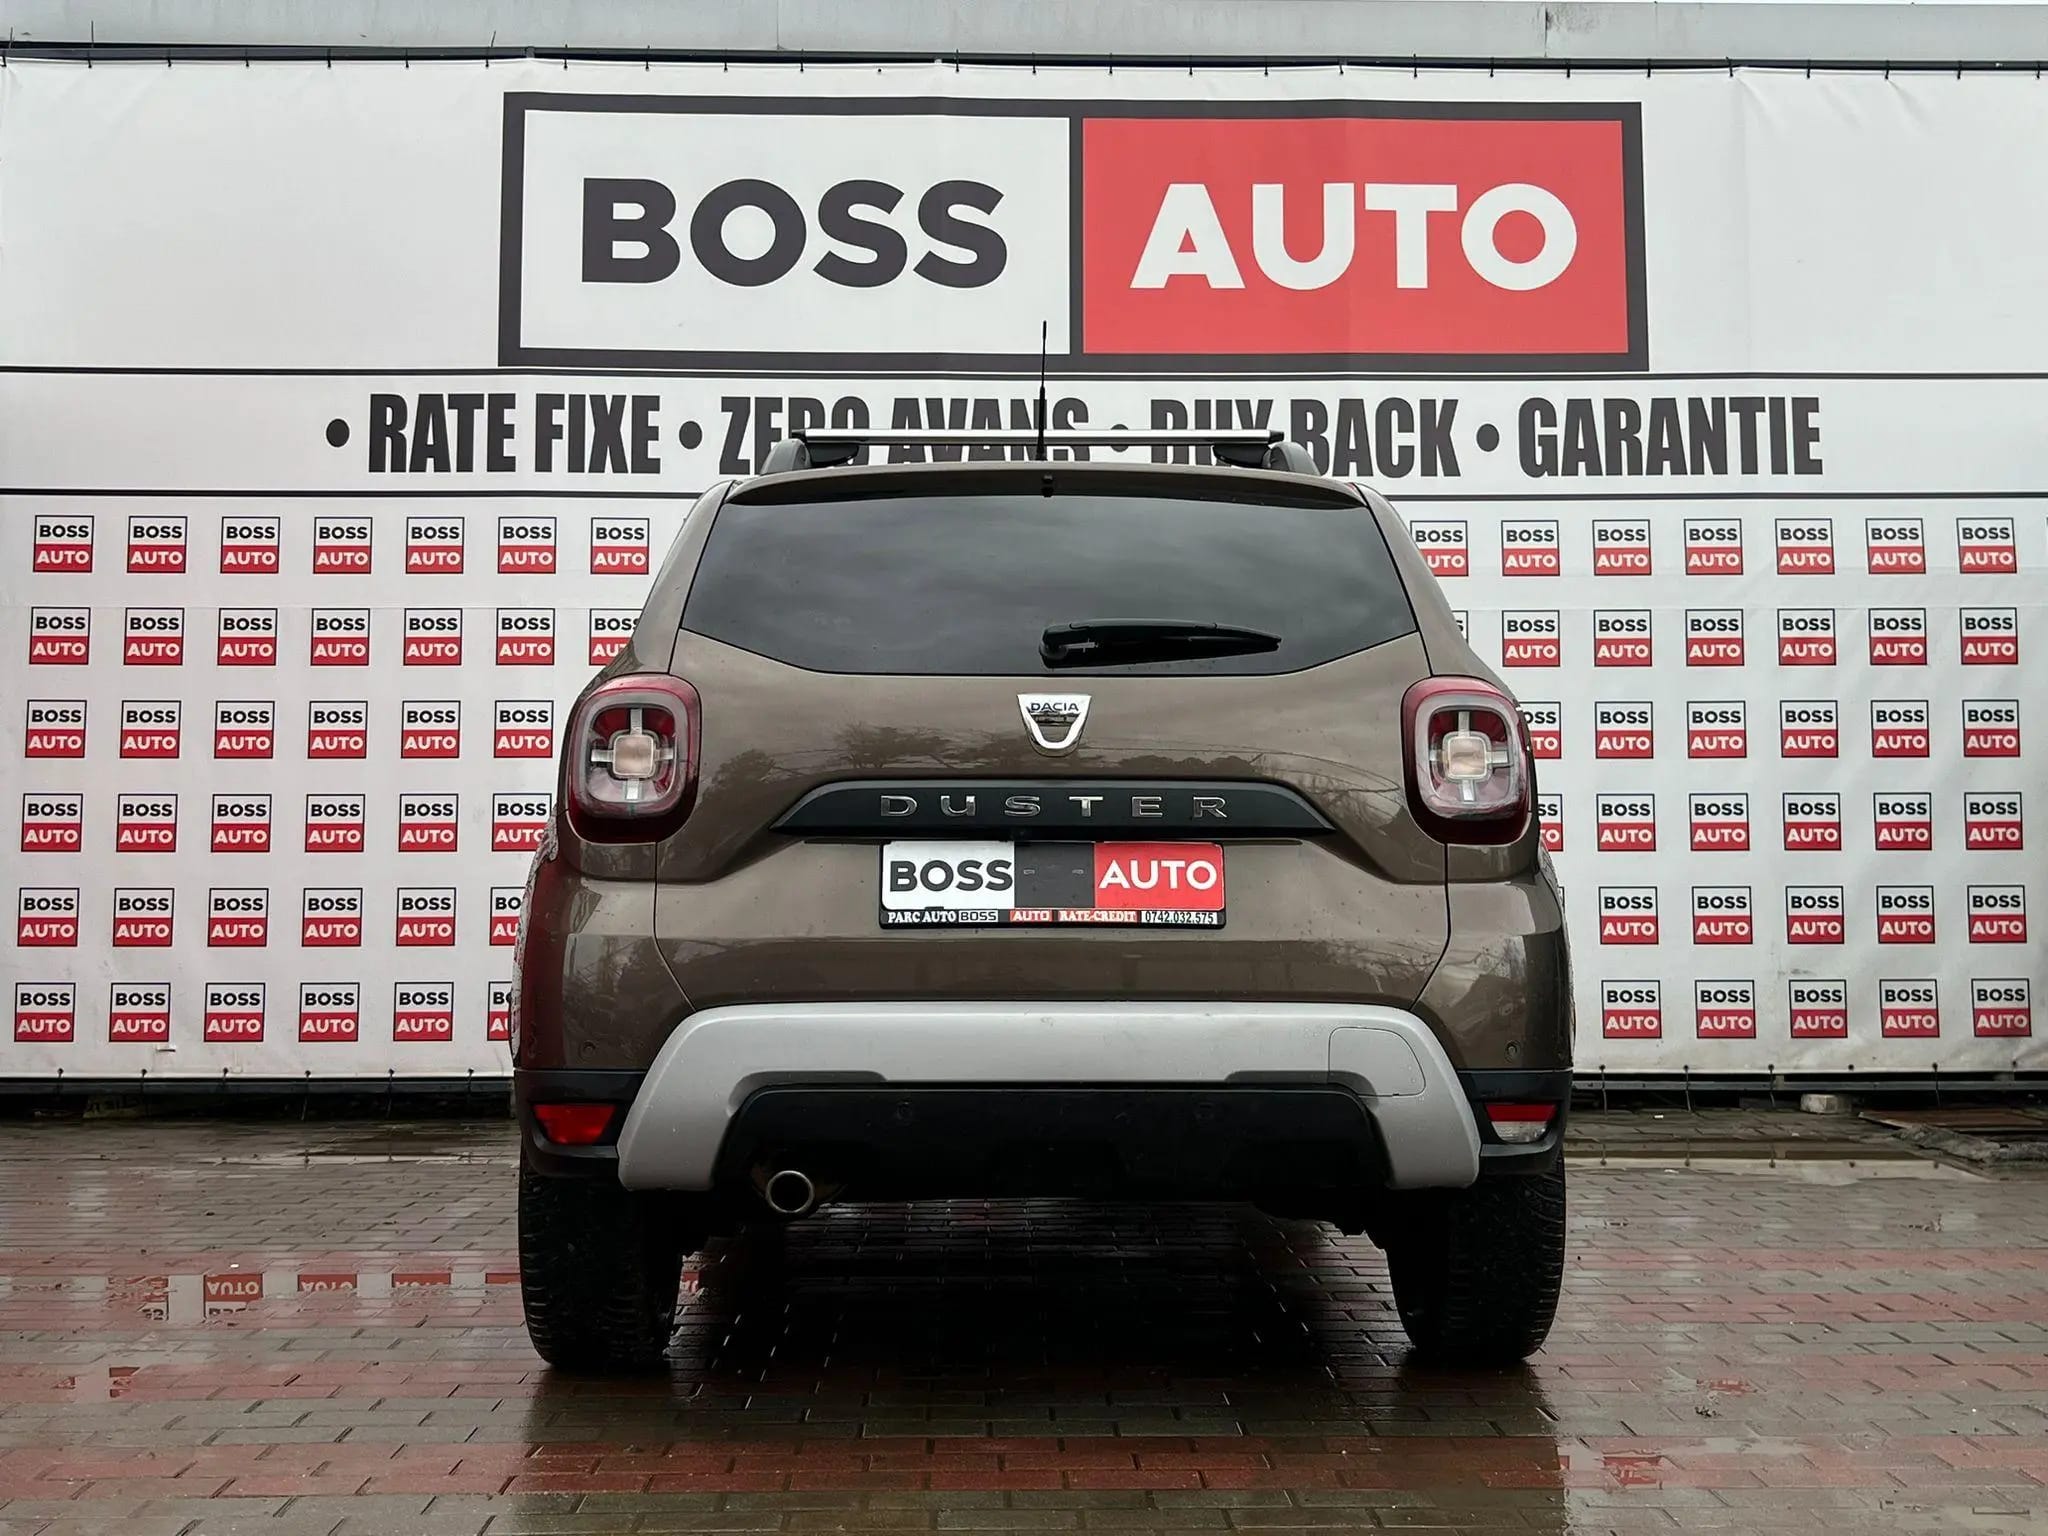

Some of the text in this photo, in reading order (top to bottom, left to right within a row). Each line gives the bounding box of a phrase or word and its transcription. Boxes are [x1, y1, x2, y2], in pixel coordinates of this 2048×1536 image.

[582, 177, 1578, 291] BOSS AUTO
[367, 392, 517, 474] RATE
[533, 393, 662, 475] FIXE
[1289, 396, 1462, 479] BACK
[1517, 396, 1824, 479] GARANTIE
[39, 524, 90, 539] BOSS
[132, 525, 183, 539] BOSS
[225, 525, 276, 540] BOSS
[318, 526, 368, 540] BOSS
[410, 526, 460, 540] BOSS
[502, 525, 553, 540] BOSS
[595, 526, 645, 541] BOSS
[1505, 529, 1555, 543] BOSS
[1597, 528, 1647, 542] BOSS
[1688, 527, 1738, 542] BOSS
[1779, 527, 1829, 541] BOSS
[1870, 527, 1920, 541] BOSS
[1961, 526, 2011, 540] BOSS
[36, 550, 90, 564] AUTO
[130, 550, 183, 565] AUTO
[223, 551, 276, 565] AUTO
[316, 551, 369, 566] AUTO
[408, 551, 461, 566] AUTO
[500, 551, 553, 565] AUTO
[593, 552, 647, 566] AUTO
[1505, 554, 1557, 568] AUTO
[1596, 553, 1649, 567] AUTO
[1688, 553, 1740, 567] AUTO
[1780, 553, 1832, 566] AUTO
[1871, 552, 1923, 566] AUTO
[1962, 551, 2014, 566] AUTO
[35, 615, 86, 630] BOSS
[129, 616, 180, 631] BOSS
[223, 617, 273, 631] BOSS
[315, 617, 366, 632] BOSS
[408, 617, 458, 631] BOSS
[501, 616, 551, 631] BOSS
[1506, 619, 1556, 633] BOSS
[1598, 618, 1648, 633] BOSS
[1690, 618, 1740, 632] BOSS
[1782, 617, 1831, 632] BOSS
[1873, 617, 1923, 631] BOSS
[1964, 616, 2014, 631] BOSS
[32, 642, 86, 656] AUTO
[126, 642, 180, 657] AUTO
[220, 643, 274, 657] AUTO
[313, 643, 367, 657] AUTO
[406, 643, 459, 657] AUTO
[499, 642, 552, 657] AUTO
[1505, 644, 1557, 659] AUTO
[1597, 644, 1649, 658] AUTO
[1689, 644, 1741, 658] AUTO
[1781, 643, 1833, 657] AUTO
[1872, 642, 1924, 657] AUTO
[1964, 642, 2016, 657] AUTO
[1030, 702, 1080, 712] DACIA
[31, 709, 82, 723] BOSS
[125, 709, 177, 724] BOSS
[219, 710, 270, 724] BOSS
[313, 710, 364, 724] BOSS
[406, 709, 457, 724] BOSS
[499, 709, 549, 724] BOSS
[1599, 710, 1649, 725] BOSS
[1691, 710, 1742, 724] BOSS
[1784, 709, 1834, 724] BOSS
[1875, 709, 1925, 723] BOSS
[1967, 708, 2015, 723] BOSS
[28, 735, 82, 749] AUTO
[122, 735, 177, 750] AUTO
[217, 736, 271, 750] AUTO
[310, 736, 364, 750] AUTO
[403, 735, 457, 750] AUTO
[496, 735, 550, 750] AUTO
[1598, 736, 1651, 751] AUTO
[1691, 735, 1744, 750] AUTO
[1783, 735, 1836, 750] AUTO
[1875, 735, 1927, 749] AUTO
[1966, 734, 2017, 749] AUTO
[27, 802, 78, 817] BOSS
[122, 803, 173, 818] BOSS
[216, 803, 268, 818] BOSS
[310, 803, 361, 818] BOSS
[404, 803, 454, 817] BOSS
[880, 795, 1228, 818] DUSTER
[1601, 803, 1651, 817] BOSS
[1694, 802, 1745, 817] BOSS
[1787, 802, 1837, 816] BOSS
[1878, 801, 1928, 816] BOSS
[1969, 801, 2018, 816] BOSS
[23, 829, 79, 843] AUTO
[119, 829, 174, 844] AUTO
[213, 829, 268, 844] AUTO
[307, 829, 361, 844] AUTO
[401, 829, 455, 843] AUTO
[1600, 829, 1653, 843] AUTO
[1693, 828, 1747, 843] AUTO
[1786, 828, 1838, 842] AUTO
[1878, 828, 1929, 842] AUTO
[1968, 827, 2020, 842] AUTO
[889, 859, 1218, 893] BOSS AUTO
[23, 897, 75, 912] BOSS
[118, 897, 170, 912] BOSS
[213, 897, 264, 912] BOSS
[307, 897, 358, 912] BOSS
[401, 896, 452, 911] BOSS
[1603, 895, 1654, 910] BOSS
[1697, 895, 1748, 910] BOSS
[1790, 895, 1840, 910] BOSS
[1881, 895, 1930, 909] BOSS
[1972, 894, 2022, 909] BOSS
[887, 910, 921, 924] PARC
[922, 910, 957, 923] AUTO
[960, 910, 998, 922] BOSS
[1013, 910, 1051, 922] AUTO
[20, 923, 75, 938] AUTO
[115, 923, 170, 938] AUTO
[210, 924, 264, 938] AUTO
[305, 923, 359, 938] AUTO
[399, 923, 452, 938] AUTO
[1603, 922, 1656, 936] AUTO
[1696, 921, 1750, 936] AUTO
[1790, 921, 1842, 936] AUTO
[1880, 921, 1932, 935] AUTO
[1972, 920, 2024, 935] AUTO
[19, 992, 71, 1007] BOSS
[115, 992, 166, 1007] BOSS
[209, 992, 261, 1007] BOSS
[304, 992, 355, 1007] BOSS
[398, 991, 449, 1006] BOSS
[1606, 989, 1657, 1004] BOSS
[1700, 989, 1751, 1004] BOSS
[1793, 989, 1843, 1003] BOSS
[1884, 988, 1934, 1003] BOSS
[1976, 987, 2026, 1002] BOSS
[17, 1019, 71, 1033] AUTO
[111, 1019, 166, 1033] AUTO
[206, 1018, 261, 1033] AUTO
[301, 1018, 356, 1033] AUTO
[395, 1018, 450, 1033] AUTO
[1605, 1015, 1658, 1030] AUTO
[1699, 1015, 1753, 1030] AUTO
[1793, 1015, 1844, 1030] AUTO
[1884, 1015, 1936, 1029] AUTO
